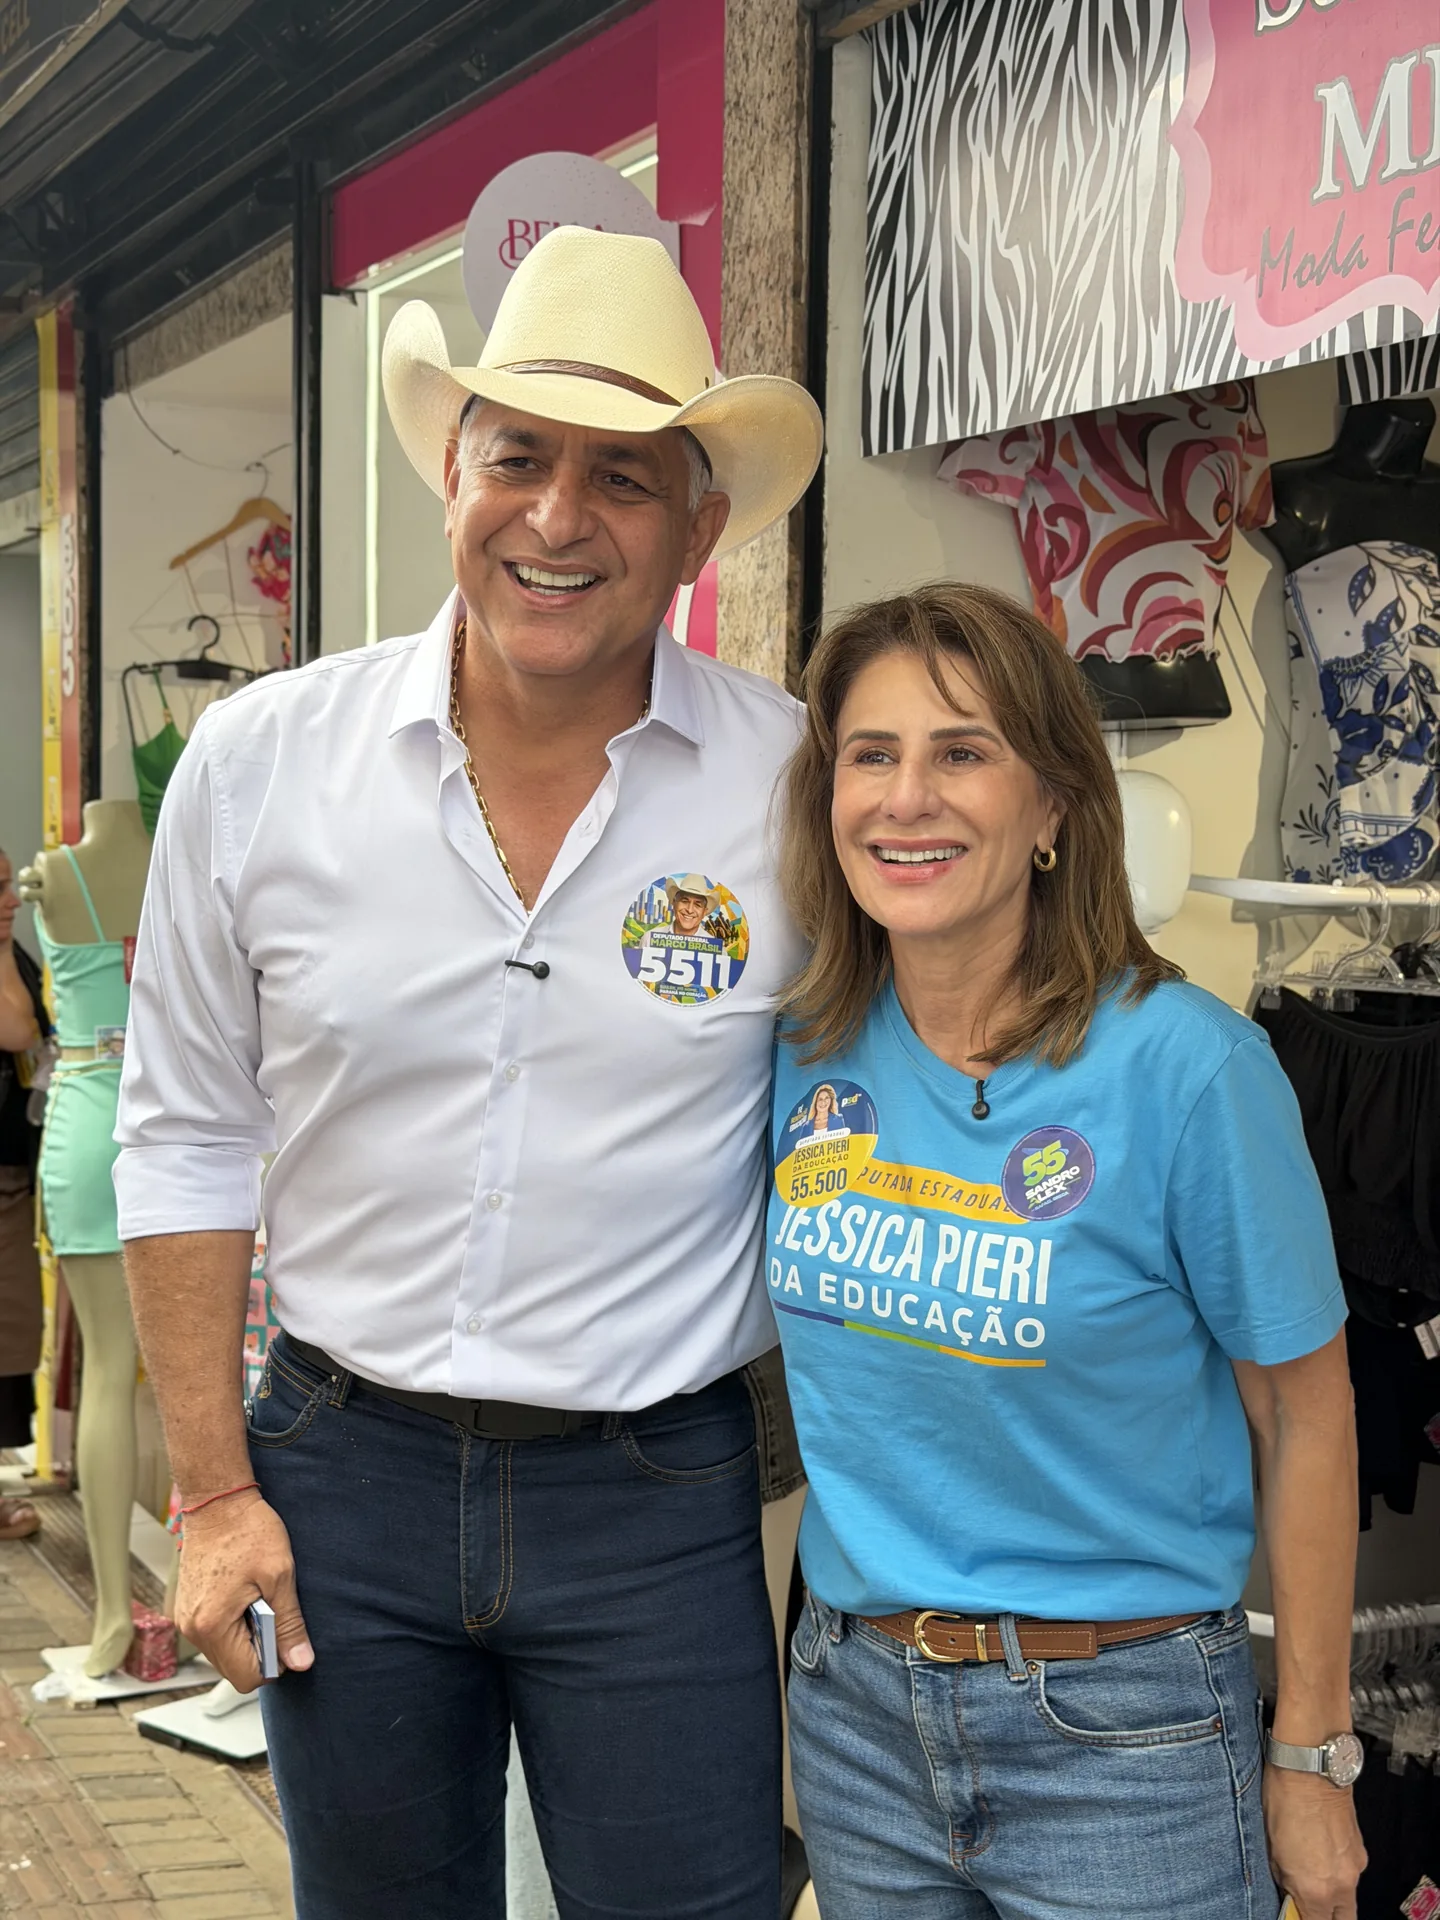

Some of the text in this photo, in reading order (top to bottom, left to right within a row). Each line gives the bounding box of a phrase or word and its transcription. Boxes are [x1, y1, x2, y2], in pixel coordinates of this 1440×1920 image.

[1258, 187, 1440, 298] Moda Fe
[650, 938, 722, 953] MARCO BRASIL
[653, 933, 710, 944] DEPUTADO FEDERAL
[637, 946, 732, 990] 5511
[841, 1094, 859, 1108] psd
[793, 1138, 850, 1165] JESSICA PIERI
[793, 1152, 849, 1174] DA EDUCAÇÃO
[1022, 1139, 1067, 1187] 55
[789, 1167, 848, 1202] 55.500
[857, 1165, 913, 1193] PUTADA
[1025, 1165, 1080, 1200] SANDRO
[774, 1199, 1053, 1306] JESSICA PIERI
[769, 1256, 1047, 1348] DA EDUCAÇÃO
